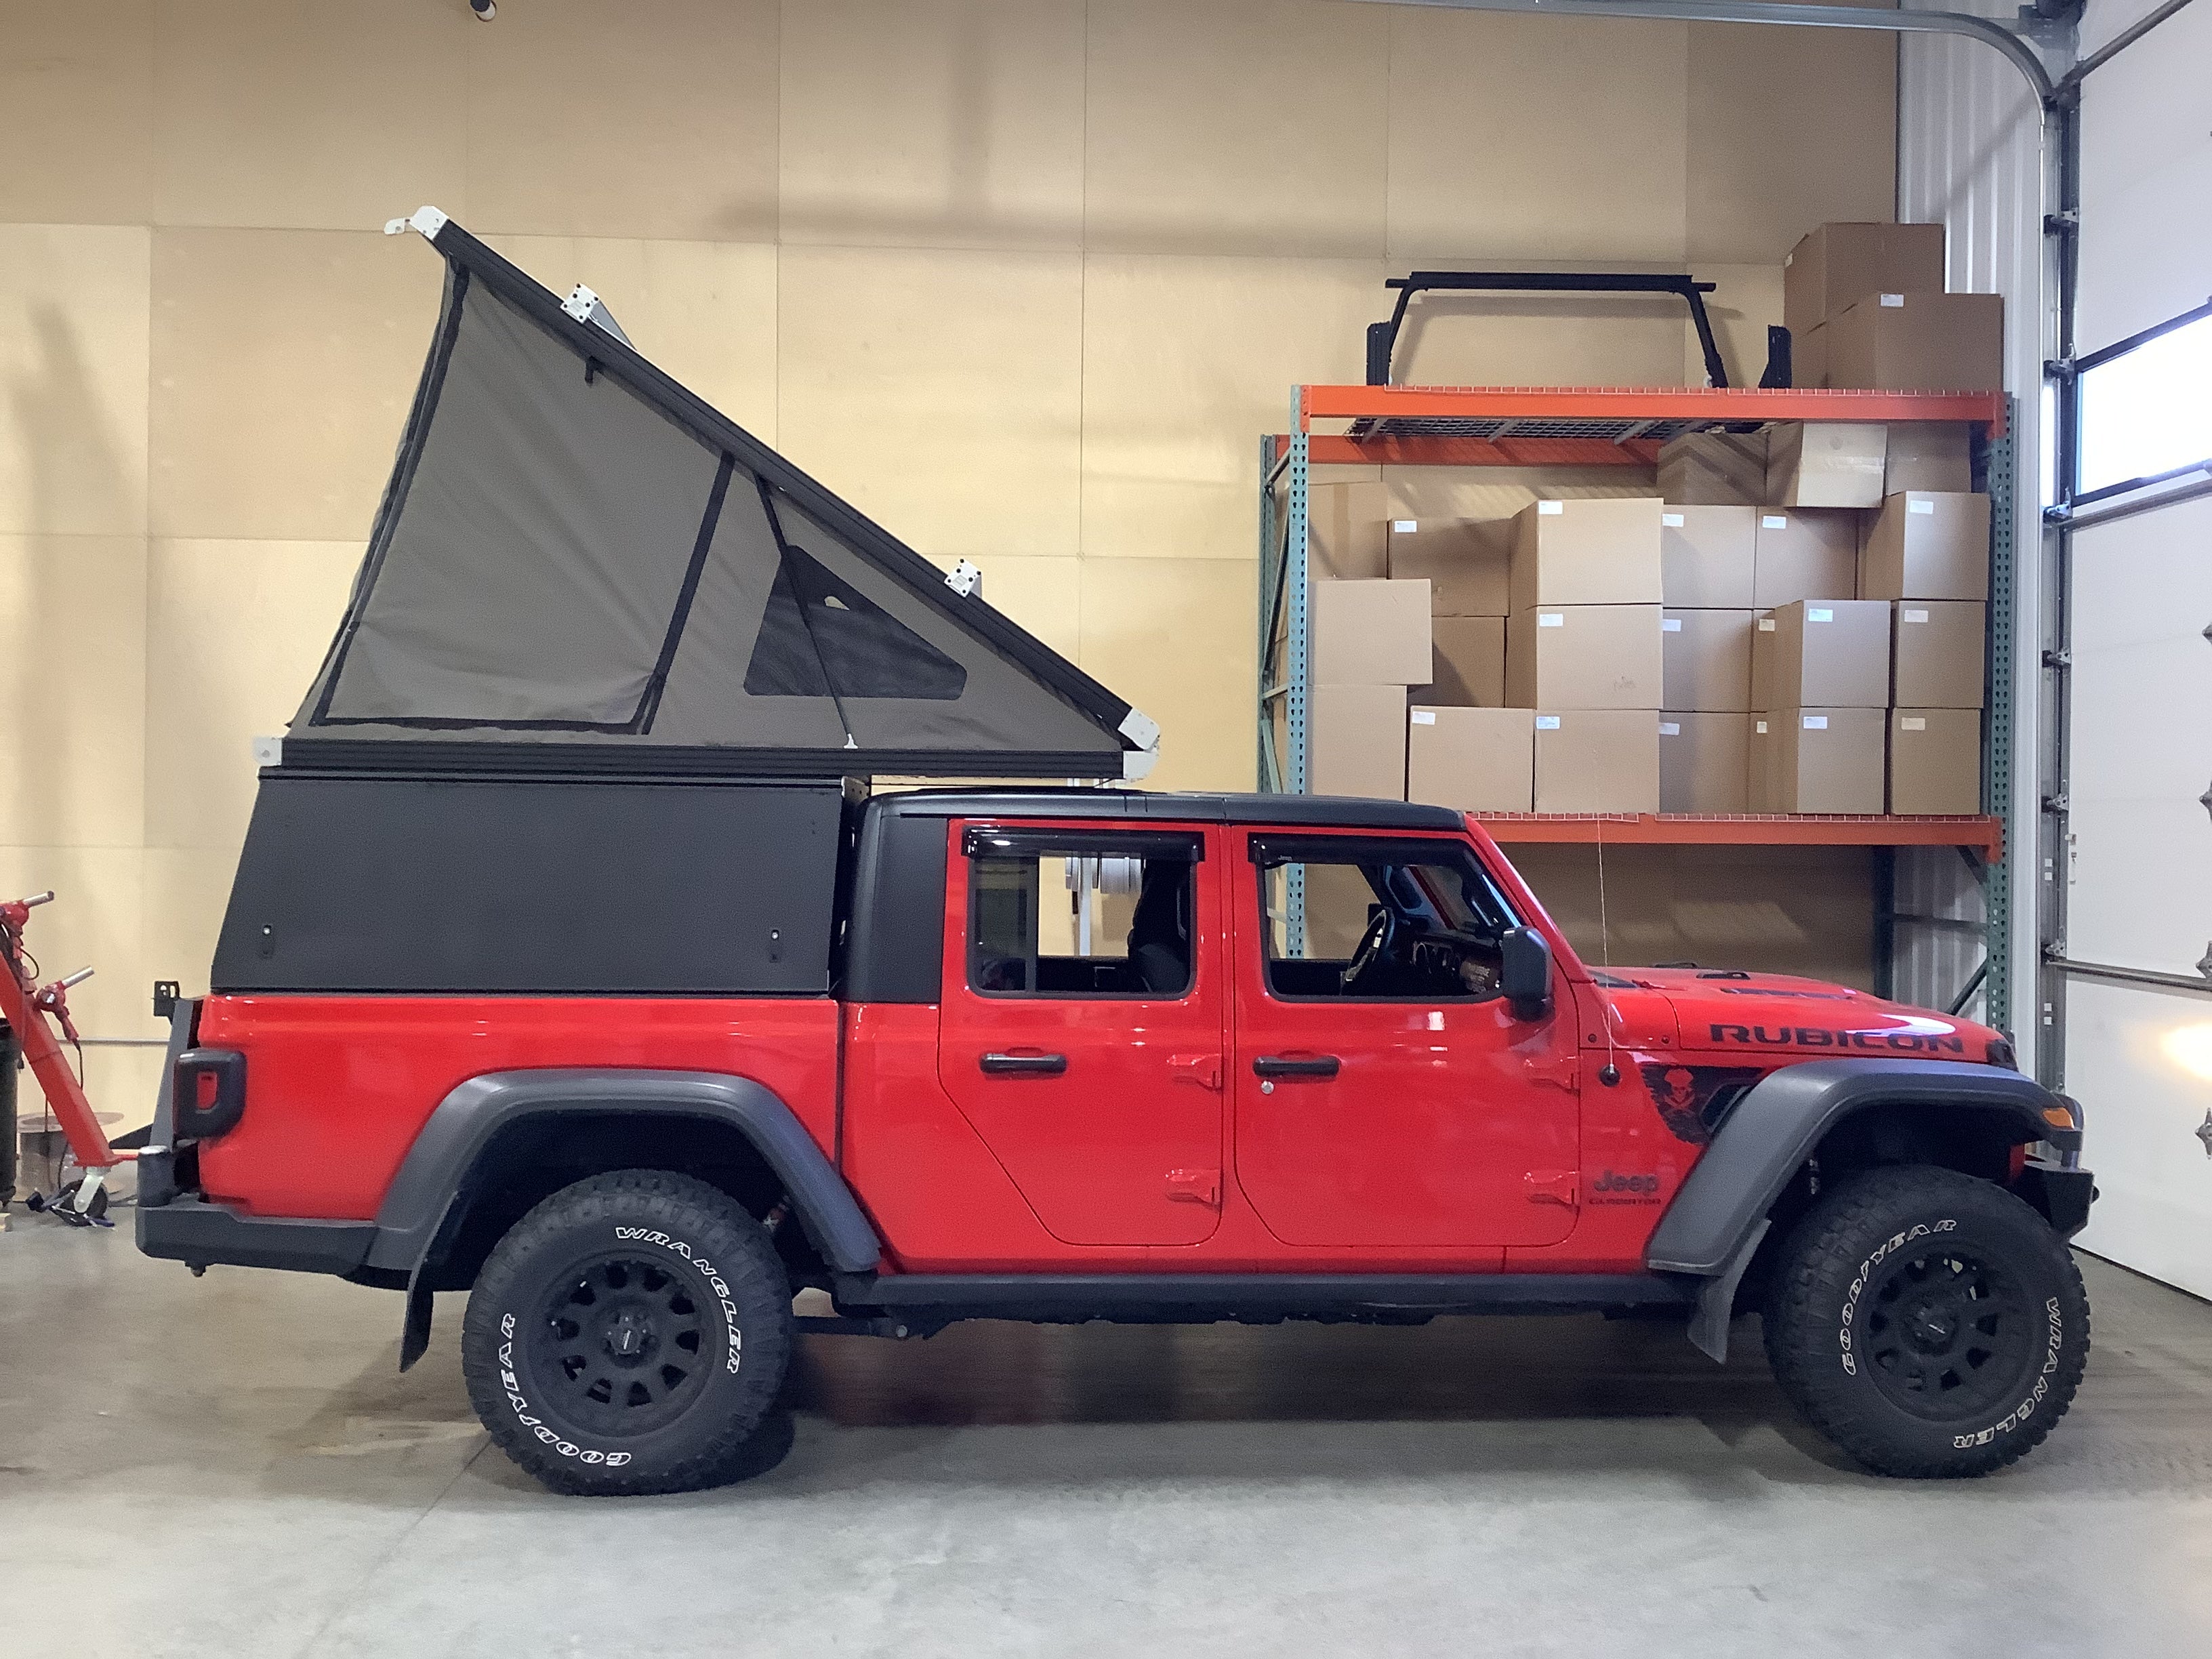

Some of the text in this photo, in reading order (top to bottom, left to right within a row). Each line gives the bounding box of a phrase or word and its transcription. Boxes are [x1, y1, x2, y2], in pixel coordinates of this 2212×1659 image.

[1709, 1023, 1965, 1053] RUBICON
[1593, 1169, 1660, 1197] Jeep
[615, 1227, 741, 1374] WRANGLER
[1840, 1219, 1957, 1376] GOODYEAR
[1953, 1296, 2062, 1449] WRANGLER
[498, 1313, 632, 1467] GOODYEAR
